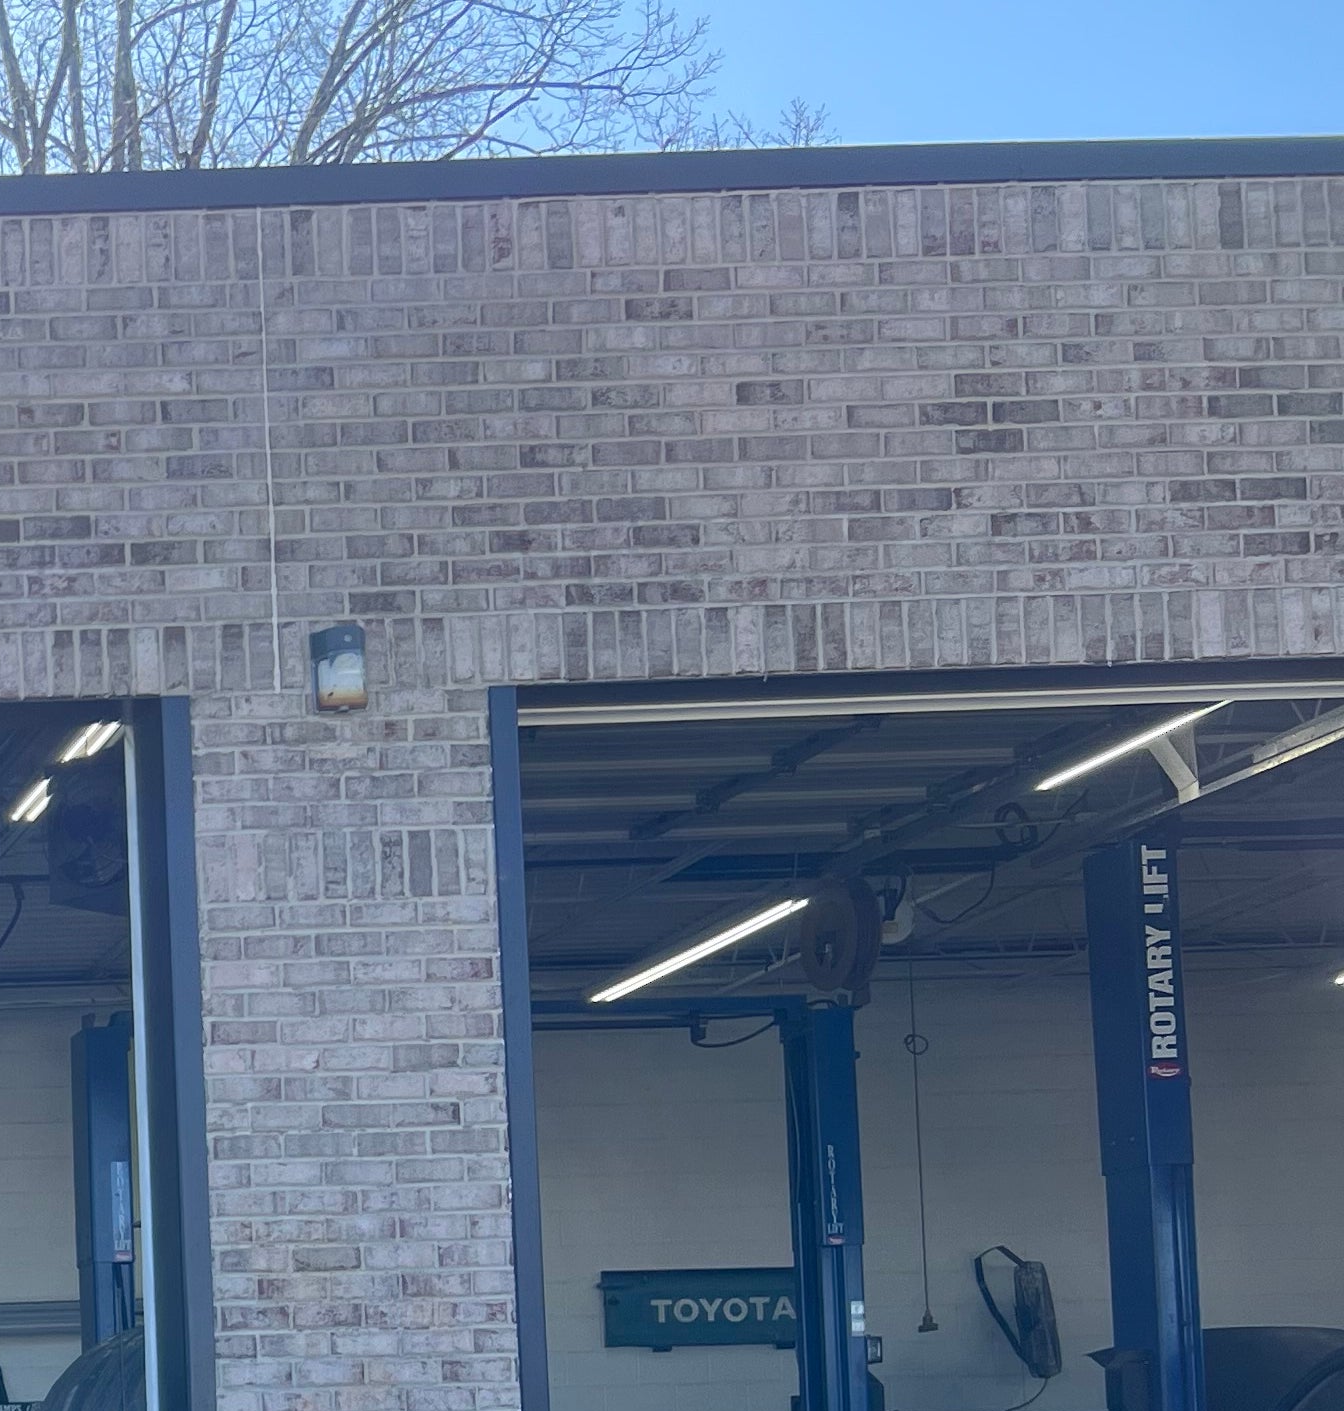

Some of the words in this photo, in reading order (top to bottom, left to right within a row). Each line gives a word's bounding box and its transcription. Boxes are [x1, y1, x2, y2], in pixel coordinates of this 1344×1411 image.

[1140, 844, 1169, 914] LIFT
[1145, 924, 1178, 1059] ROTARY
[650, 1296, 797, 1323] TOYOTA
